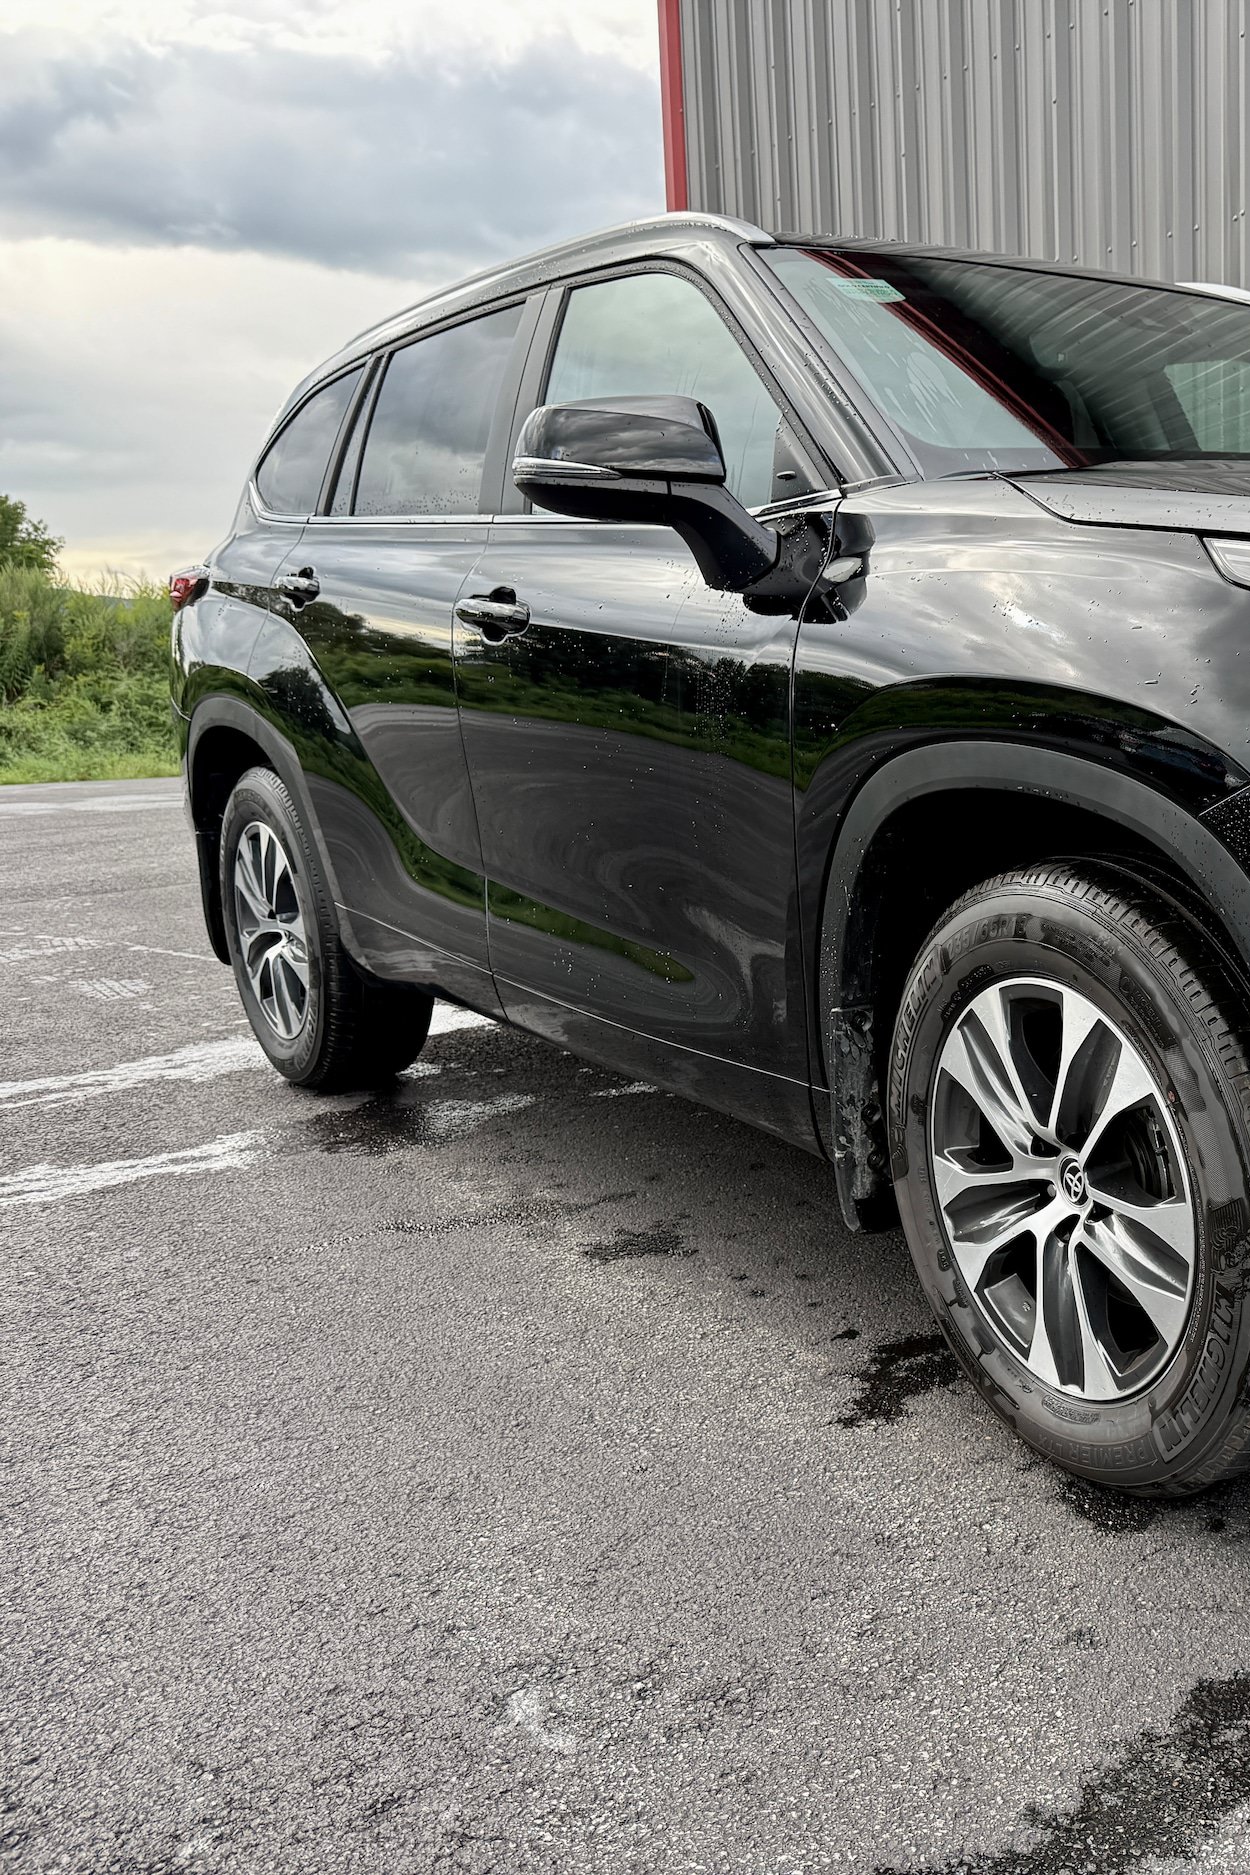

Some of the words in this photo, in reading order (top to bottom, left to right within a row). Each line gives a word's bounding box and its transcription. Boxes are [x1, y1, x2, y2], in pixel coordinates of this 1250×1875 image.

[890, 956, 939, 1118] MICHELIN
[1161, 1281, 1235, 1453] MICHELIN
[1065, 1443, 1148, 1467] PREMIER
